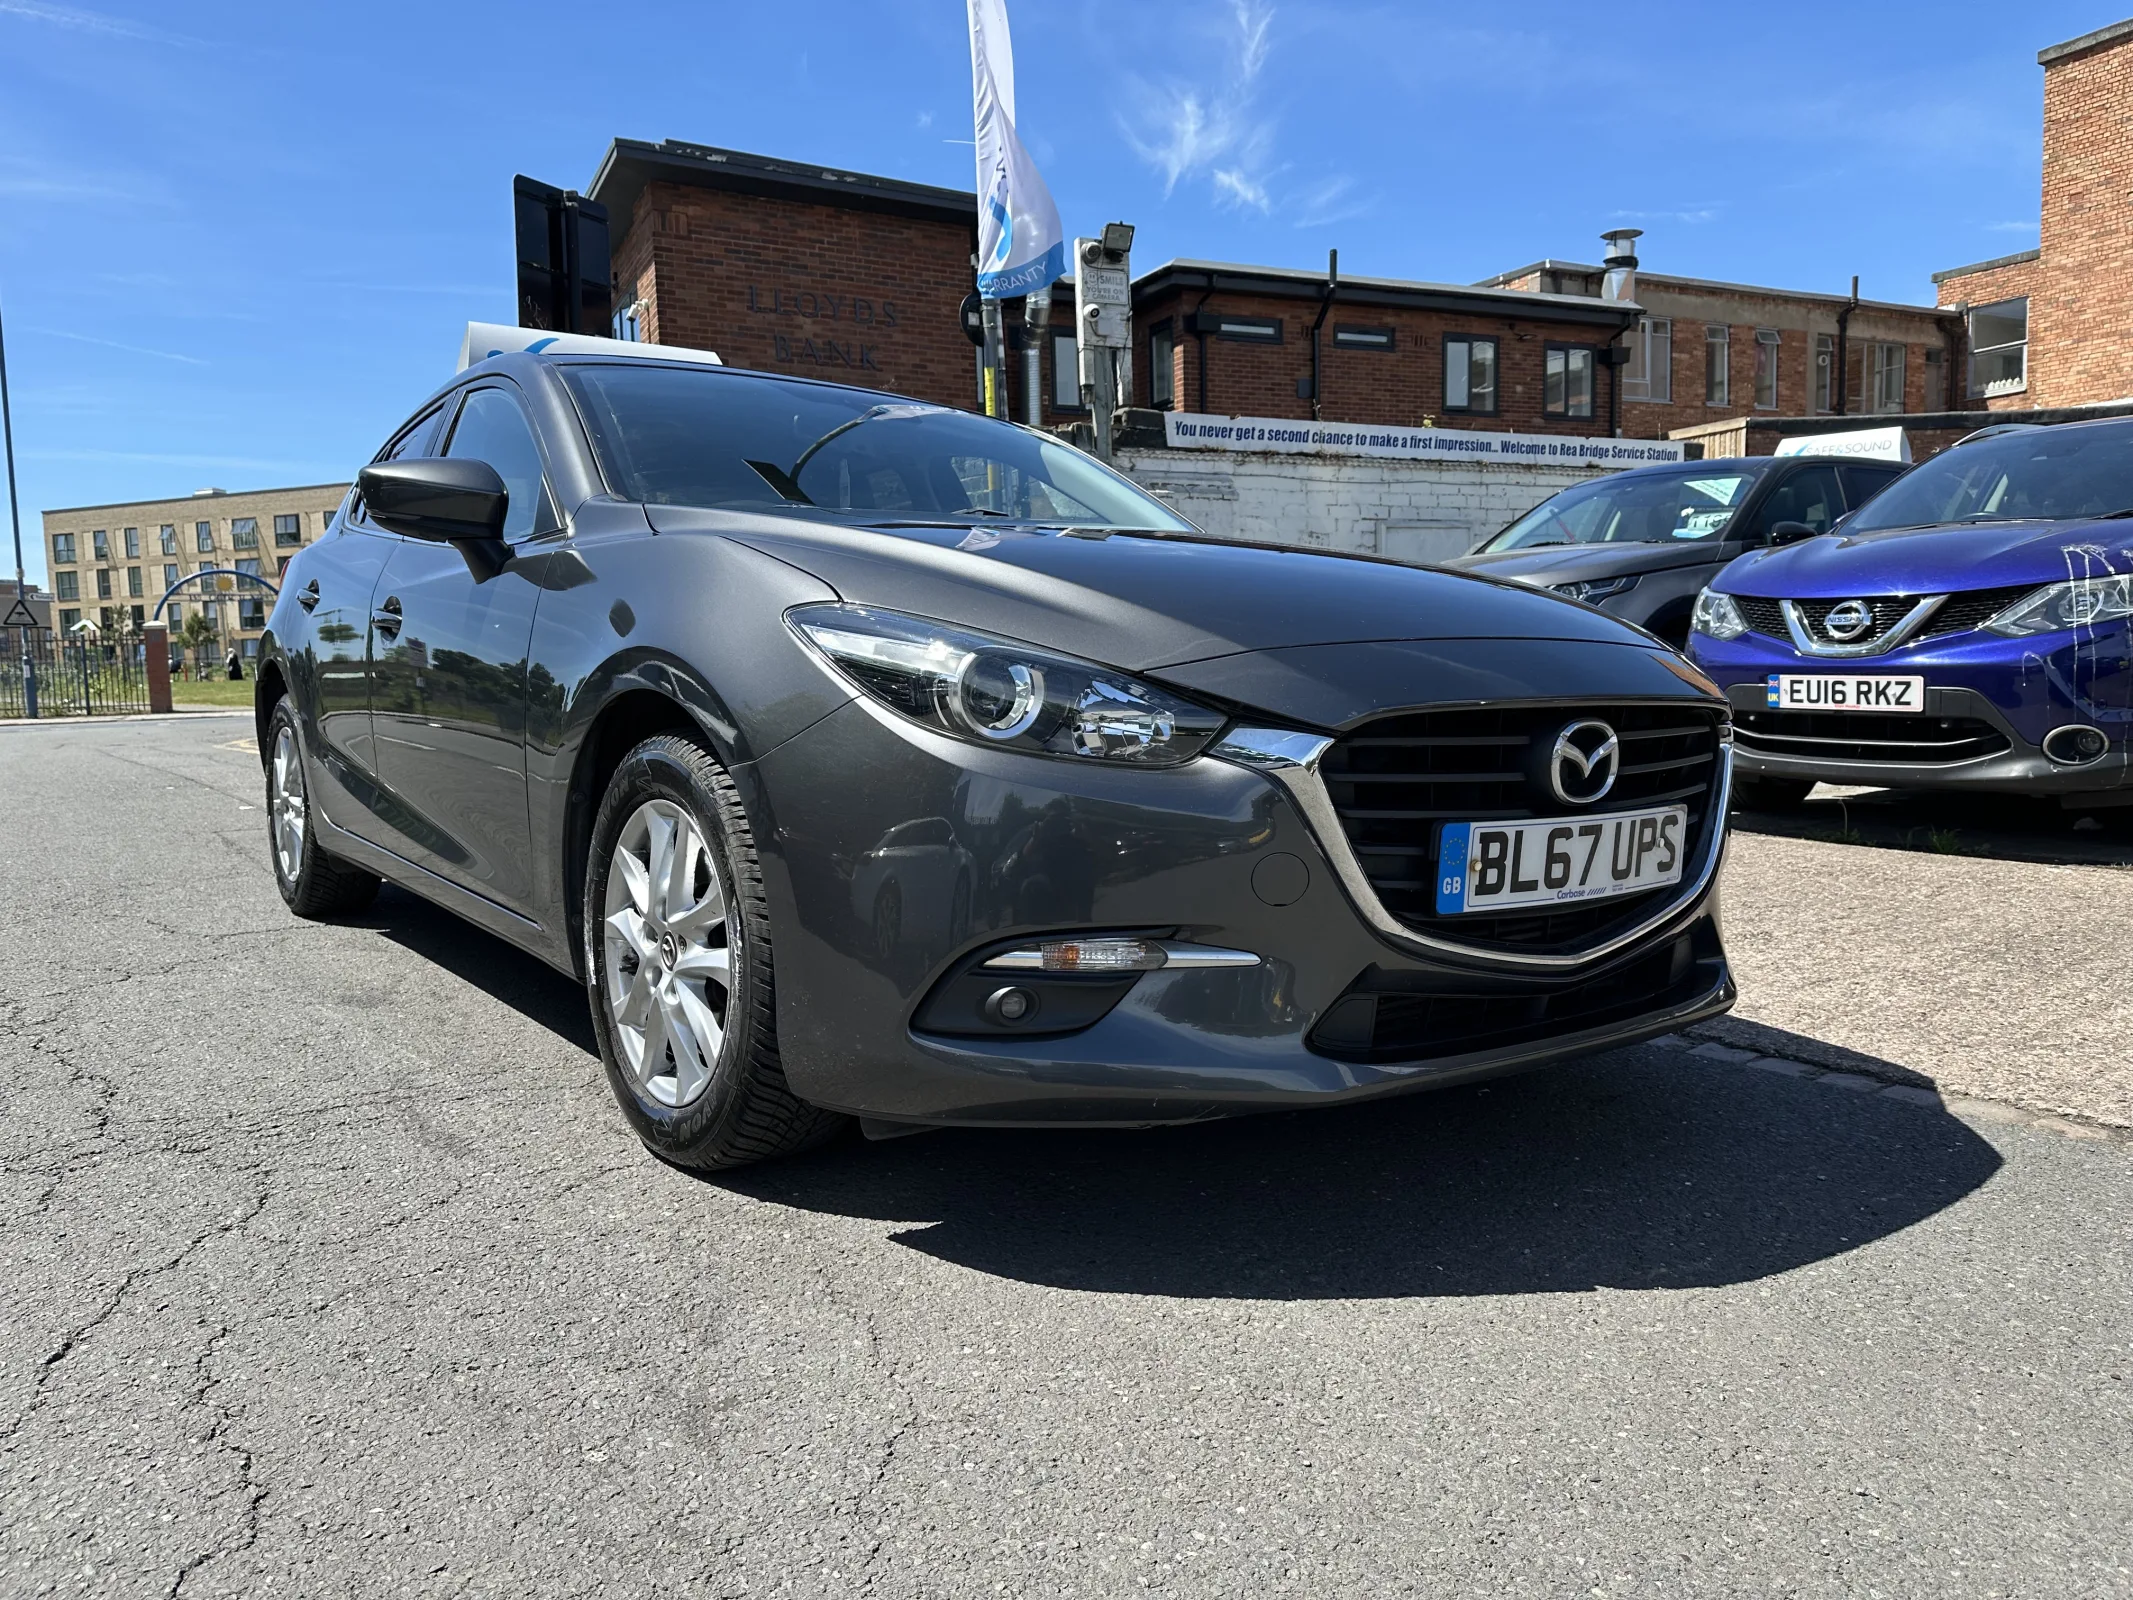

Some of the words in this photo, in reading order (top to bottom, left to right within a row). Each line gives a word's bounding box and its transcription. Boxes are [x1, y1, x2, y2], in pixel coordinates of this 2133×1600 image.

[1100, 275, 1124, 286] SMILE
[746, 285, 898, 327] LLOYDS
[774, 334, 883, 372] BANK
[1175, 421, 1197, 437] You
[1199, 425, 1233, 439] never
[1235, 426, 1255, 441] get
[1257, 428, 1265, 440] a
[1267, 428, 1309, 443] second
[1312, 430, 1353, 446] chance
[1355, 431, 1367, 446] to
[1369, 433, 1399, 448] make
[1401, 436, 1407, 448] a
[1410, 435, 1432, 450] first
[1434, 436, 1499, 453] impression...
[1501, 439, 1546, 456] Welcome
[1549, 443, 1558, 456] to
[1560, 443, 1577, 457] Rea
[1579, 444, 1610, 459] Bridge
[1611, 446, 1645, 460] Service
[1647, 447, 1678, 462] Station
[1768, 692, 1779, 702] UK
[1789, 679, 1847, 705] EU16
[1856, 680, 1912, 706] RKZ
[1474, 823, 1603, 896] BL67
[1611, 814, 1679, 881] UPS
[1442, 877, 1461, 895] GB
[1556, 888, 1586, 900] Carbase
